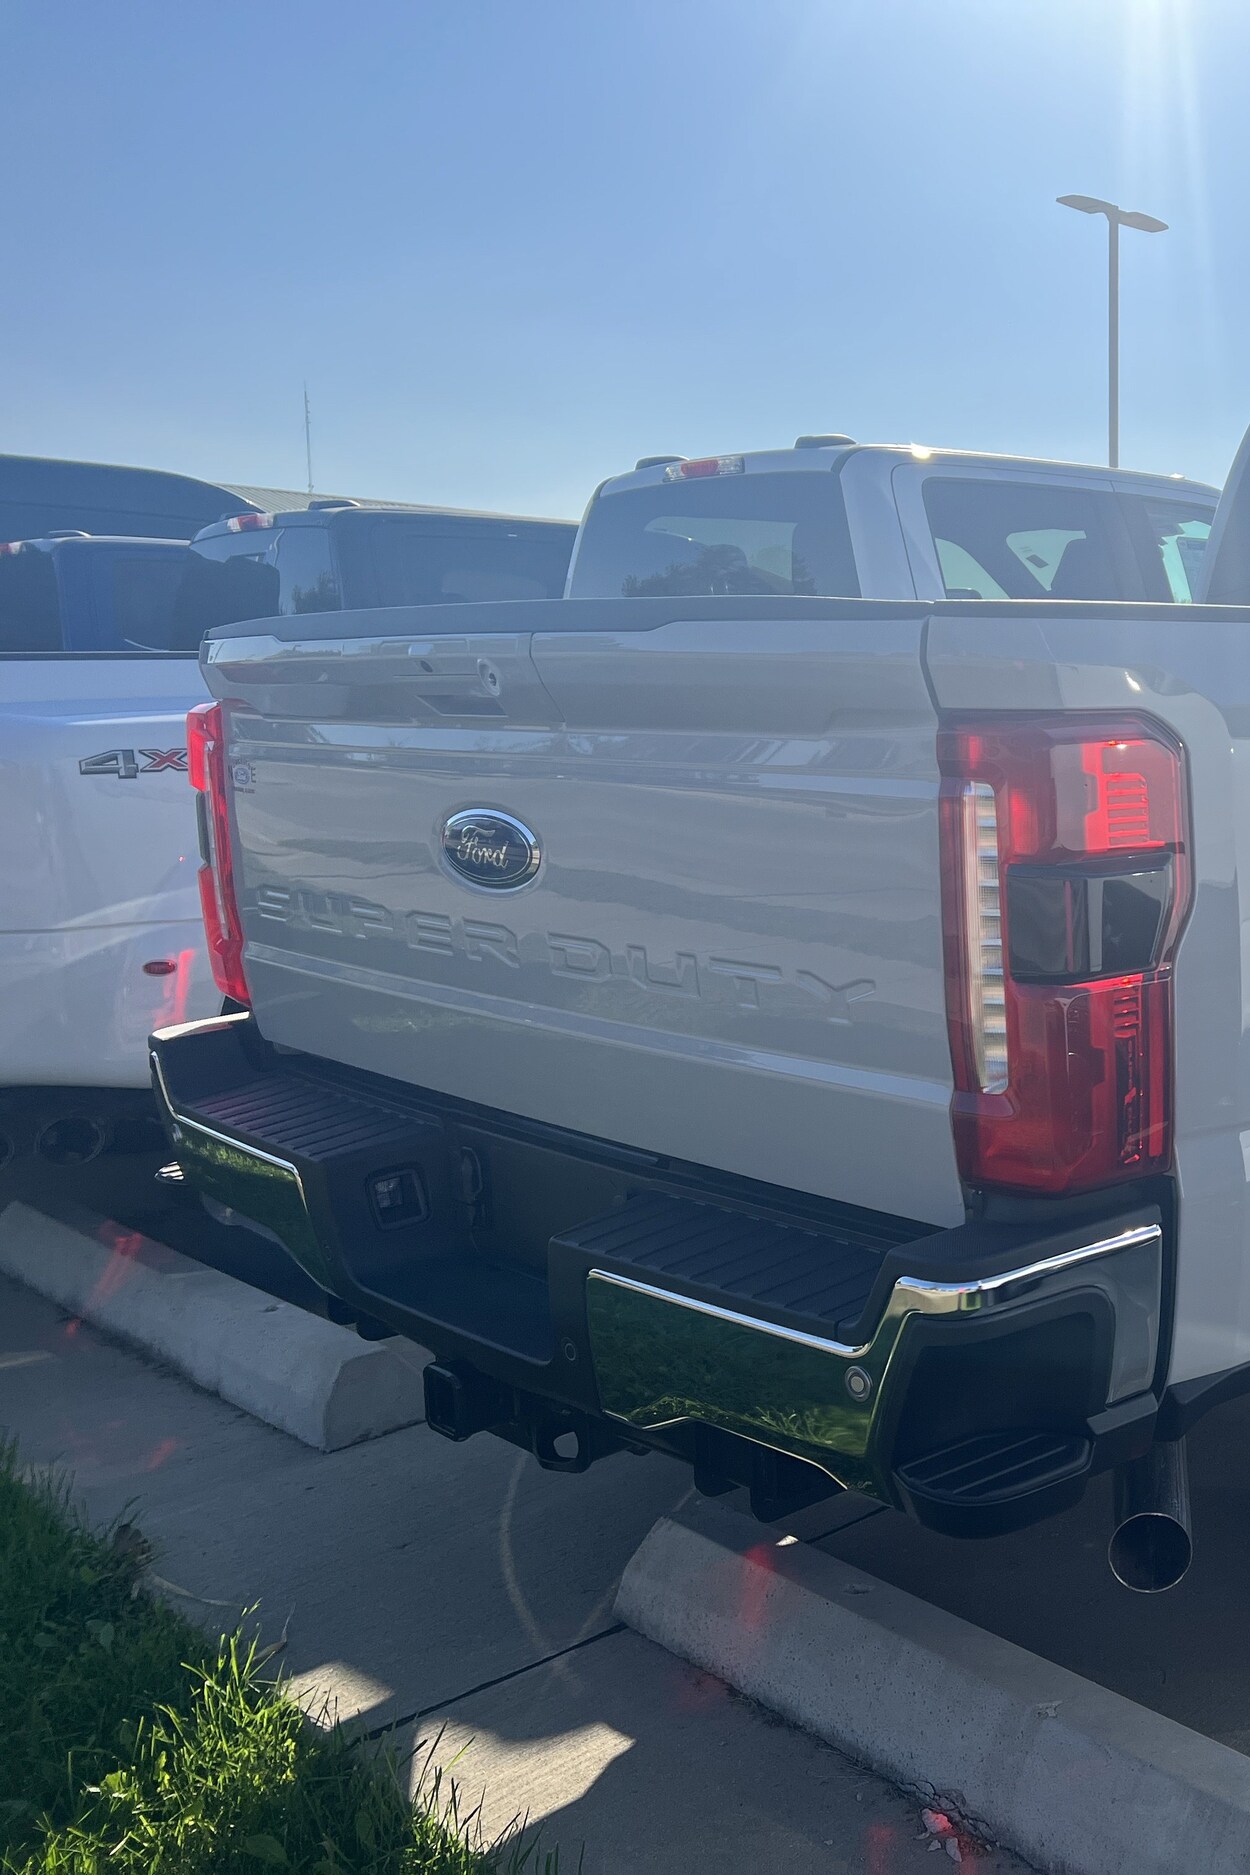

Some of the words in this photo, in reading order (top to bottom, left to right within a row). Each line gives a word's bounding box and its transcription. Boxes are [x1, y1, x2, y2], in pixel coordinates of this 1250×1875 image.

[79, 748, 189, 779] 4X
[457, 824, 509, 869] Ford
[256, 882, 521, 968] SUPER
[546, 930, 876, 1026] DUTY
